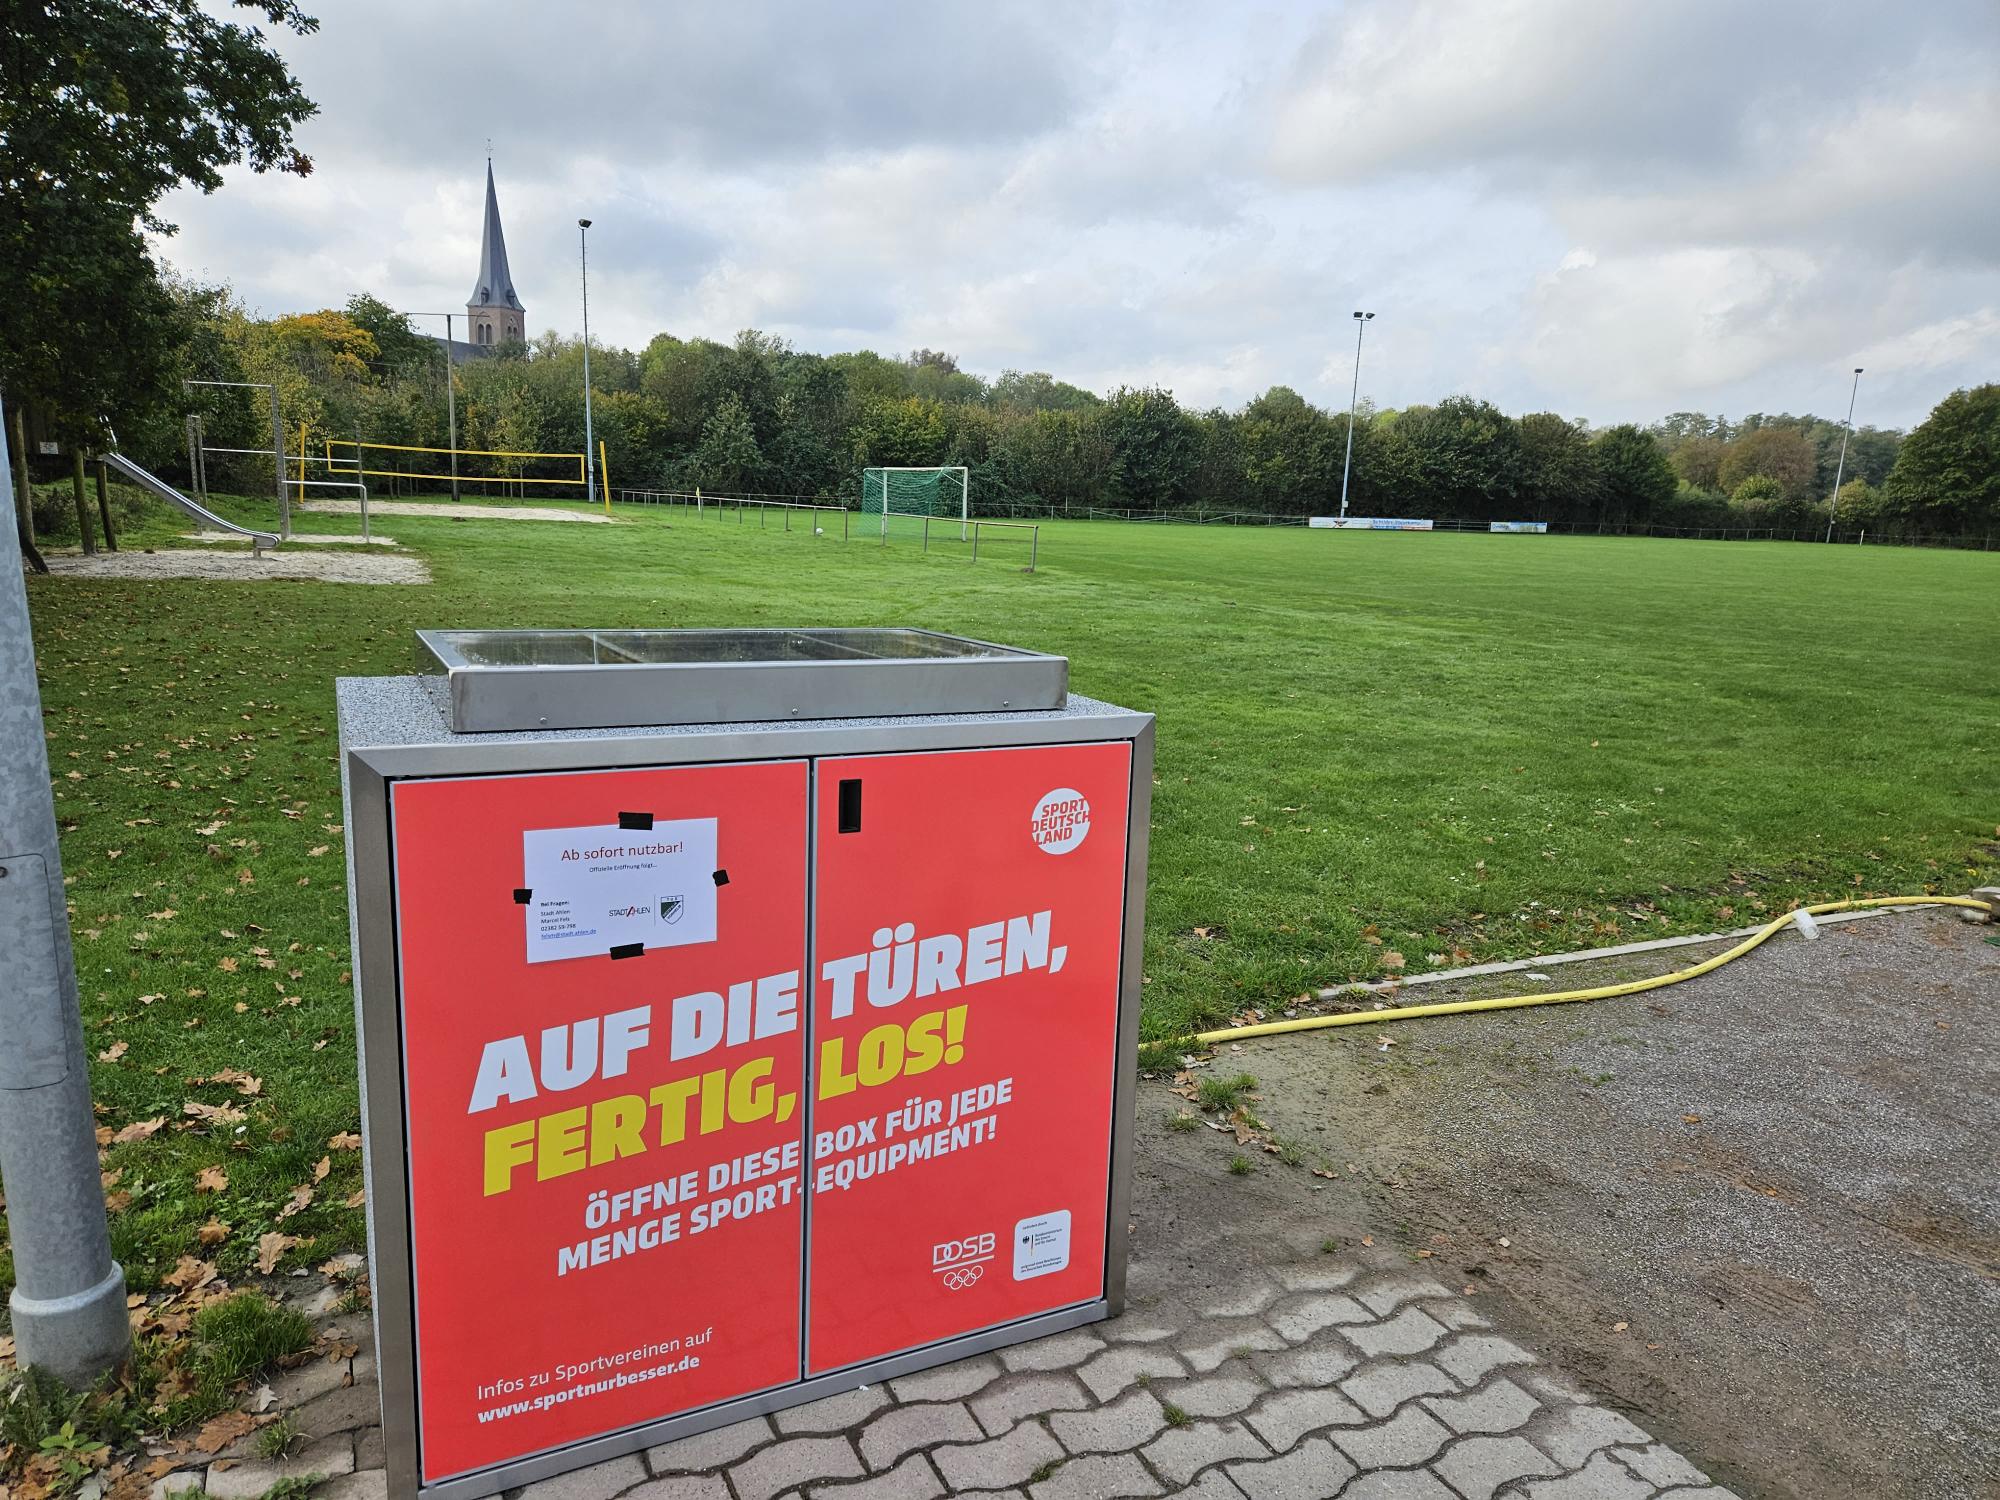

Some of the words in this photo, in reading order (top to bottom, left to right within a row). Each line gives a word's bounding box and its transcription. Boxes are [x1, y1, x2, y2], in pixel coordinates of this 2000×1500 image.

[1032, 811, 1090, 833] DEUTSCH
[1035, 827, 1073, 845] LAND
[1042, 798, 1086, 818] SPORT
[561, 849, 580, 861] Ab
[584, 846, 624, 860] sofort
[628, 841, 683, 856] nutzbar!
[467, 1004, 651, 1114] AUF
[670, 969, 799, 1062] DIE
[822, 909, 1068, 1020] TÜREN,
[484, 1056, 797, 1197] FERTIG,
[818, 1004, 968, 1101] LOS!
[585, 1171, 698, 1230] ÖFFNE
[708, 1140, 800, 1193] DIESE
[814, 1116, 878, 1160] BOX
[885, 1096, 943, 1139] FÜR
[947, 1077, 1013, 1127] JEDE
[558, 1212, 681, 1277] MENGE
[933, 1232, 996, 1266] DOSB
[477, 1379, 524, 1400] Infos
[529, 1371, 549, 1388] zu
[555, 1337, 680, 1382] Sportvereinen
[685, 1327, 713, 1348] auf
[477, 1355, 700, 1424] www.sportnurbesser.de
